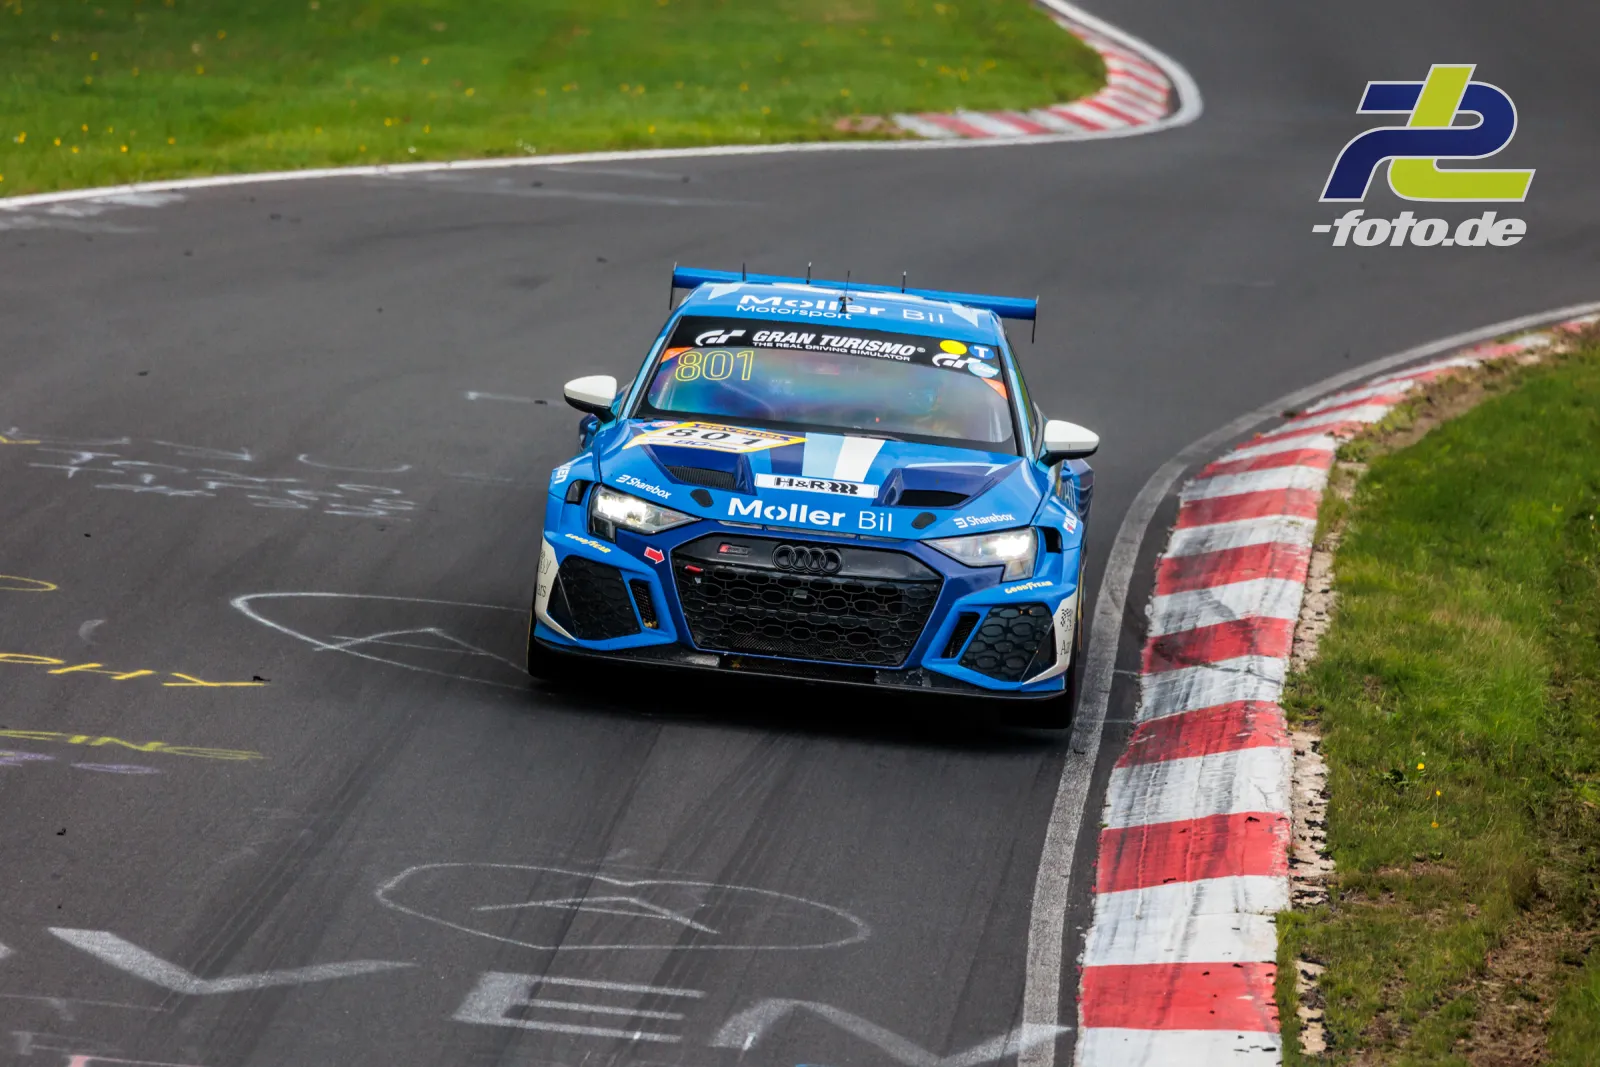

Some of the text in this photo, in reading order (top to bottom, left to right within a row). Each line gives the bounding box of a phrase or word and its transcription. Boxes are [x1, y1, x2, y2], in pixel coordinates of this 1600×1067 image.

[736, 305, 852, 320] Motorsport
[903, 309, 944, 324] Bil
[752, 330, 816, 344] GRAN
[805, 345, 847, 353] DRIVING
[850, 349, 910, 361] SIMULATOR
[675, 350, 754, 382] 801
[667, 428, 760, 445] 801
[626, 478, 672, 499] Sharebox
[774, 477, 825, 490] H&R
[858, 510, 893, 532] Bil
[968, 513, 1016, 526] Sharebox
